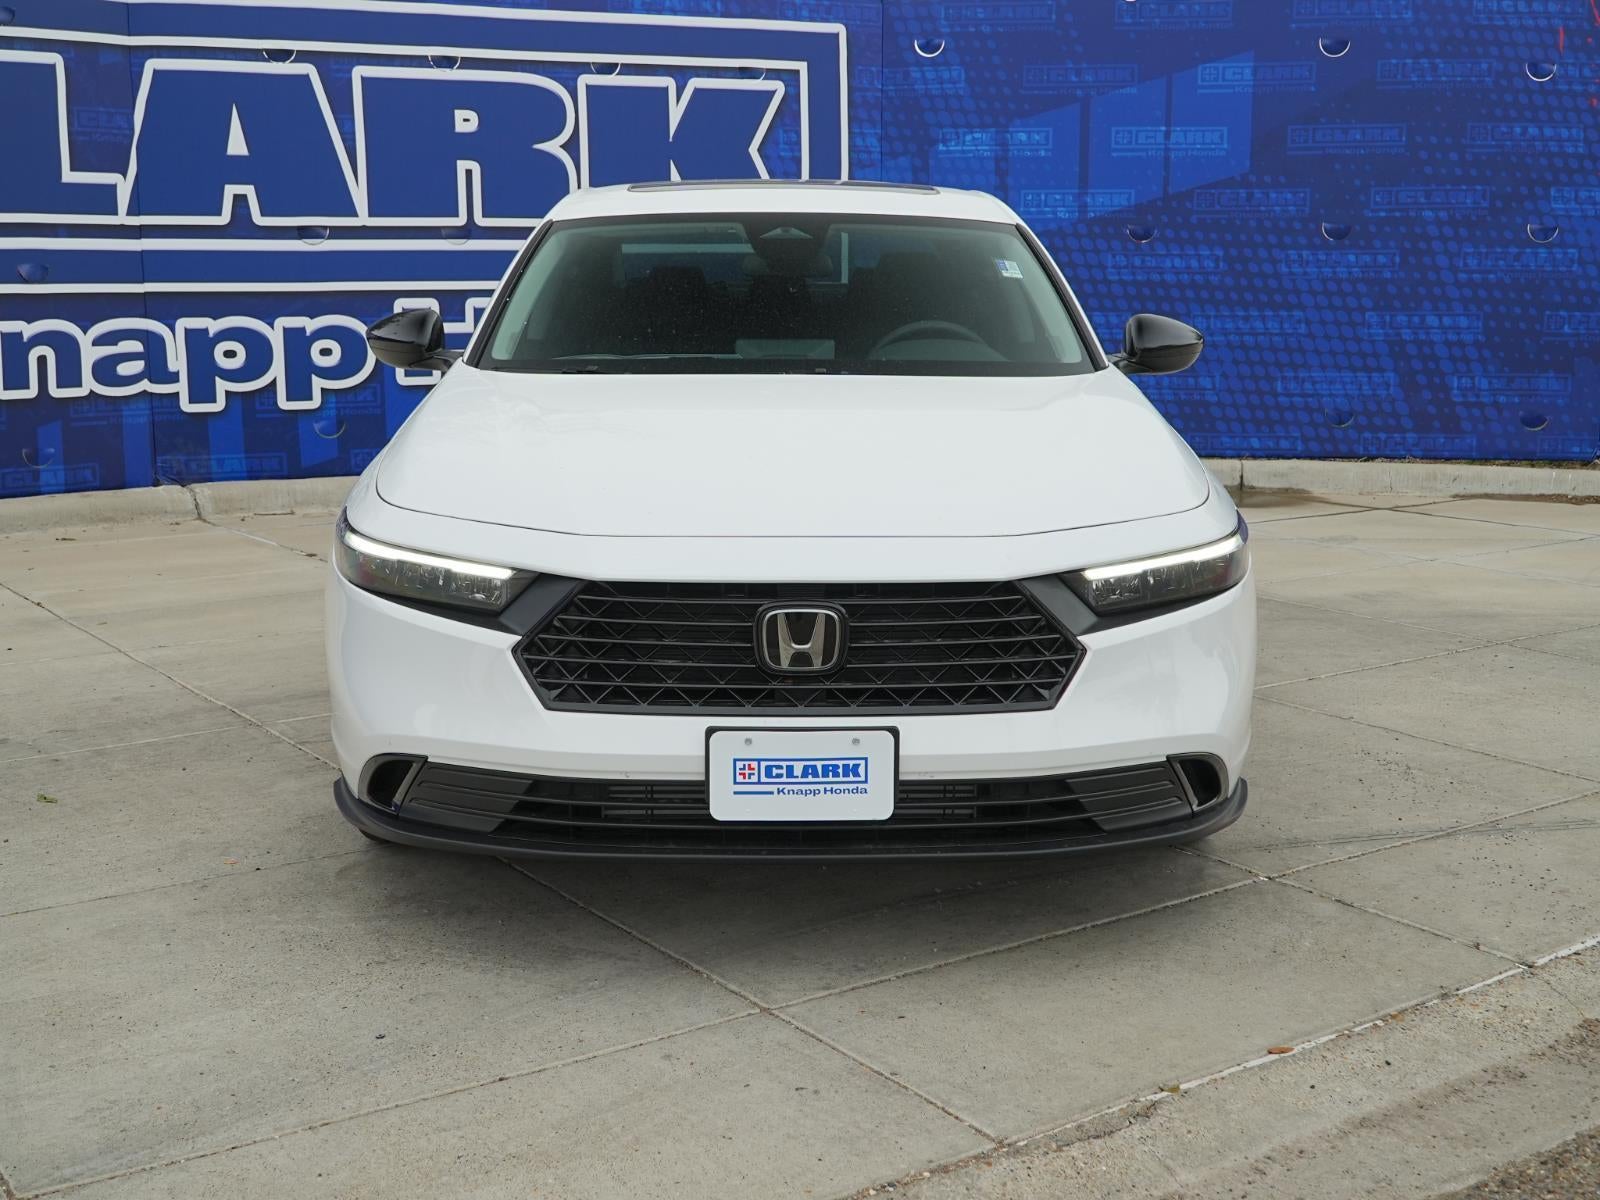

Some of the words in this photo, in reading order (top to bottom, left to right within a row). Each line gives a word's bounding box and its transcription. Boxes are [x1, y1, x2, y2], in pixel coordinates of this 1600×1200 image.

[0, 50, 785, 229] LARK
[1137, 131, 1222, 144] CLARK
[0, 314, 376, 412] napp
[764, 763, 862, 779] CLARK
[777, 787, 821, 797] Knapp
[823, 786, 868, 795] Honda
